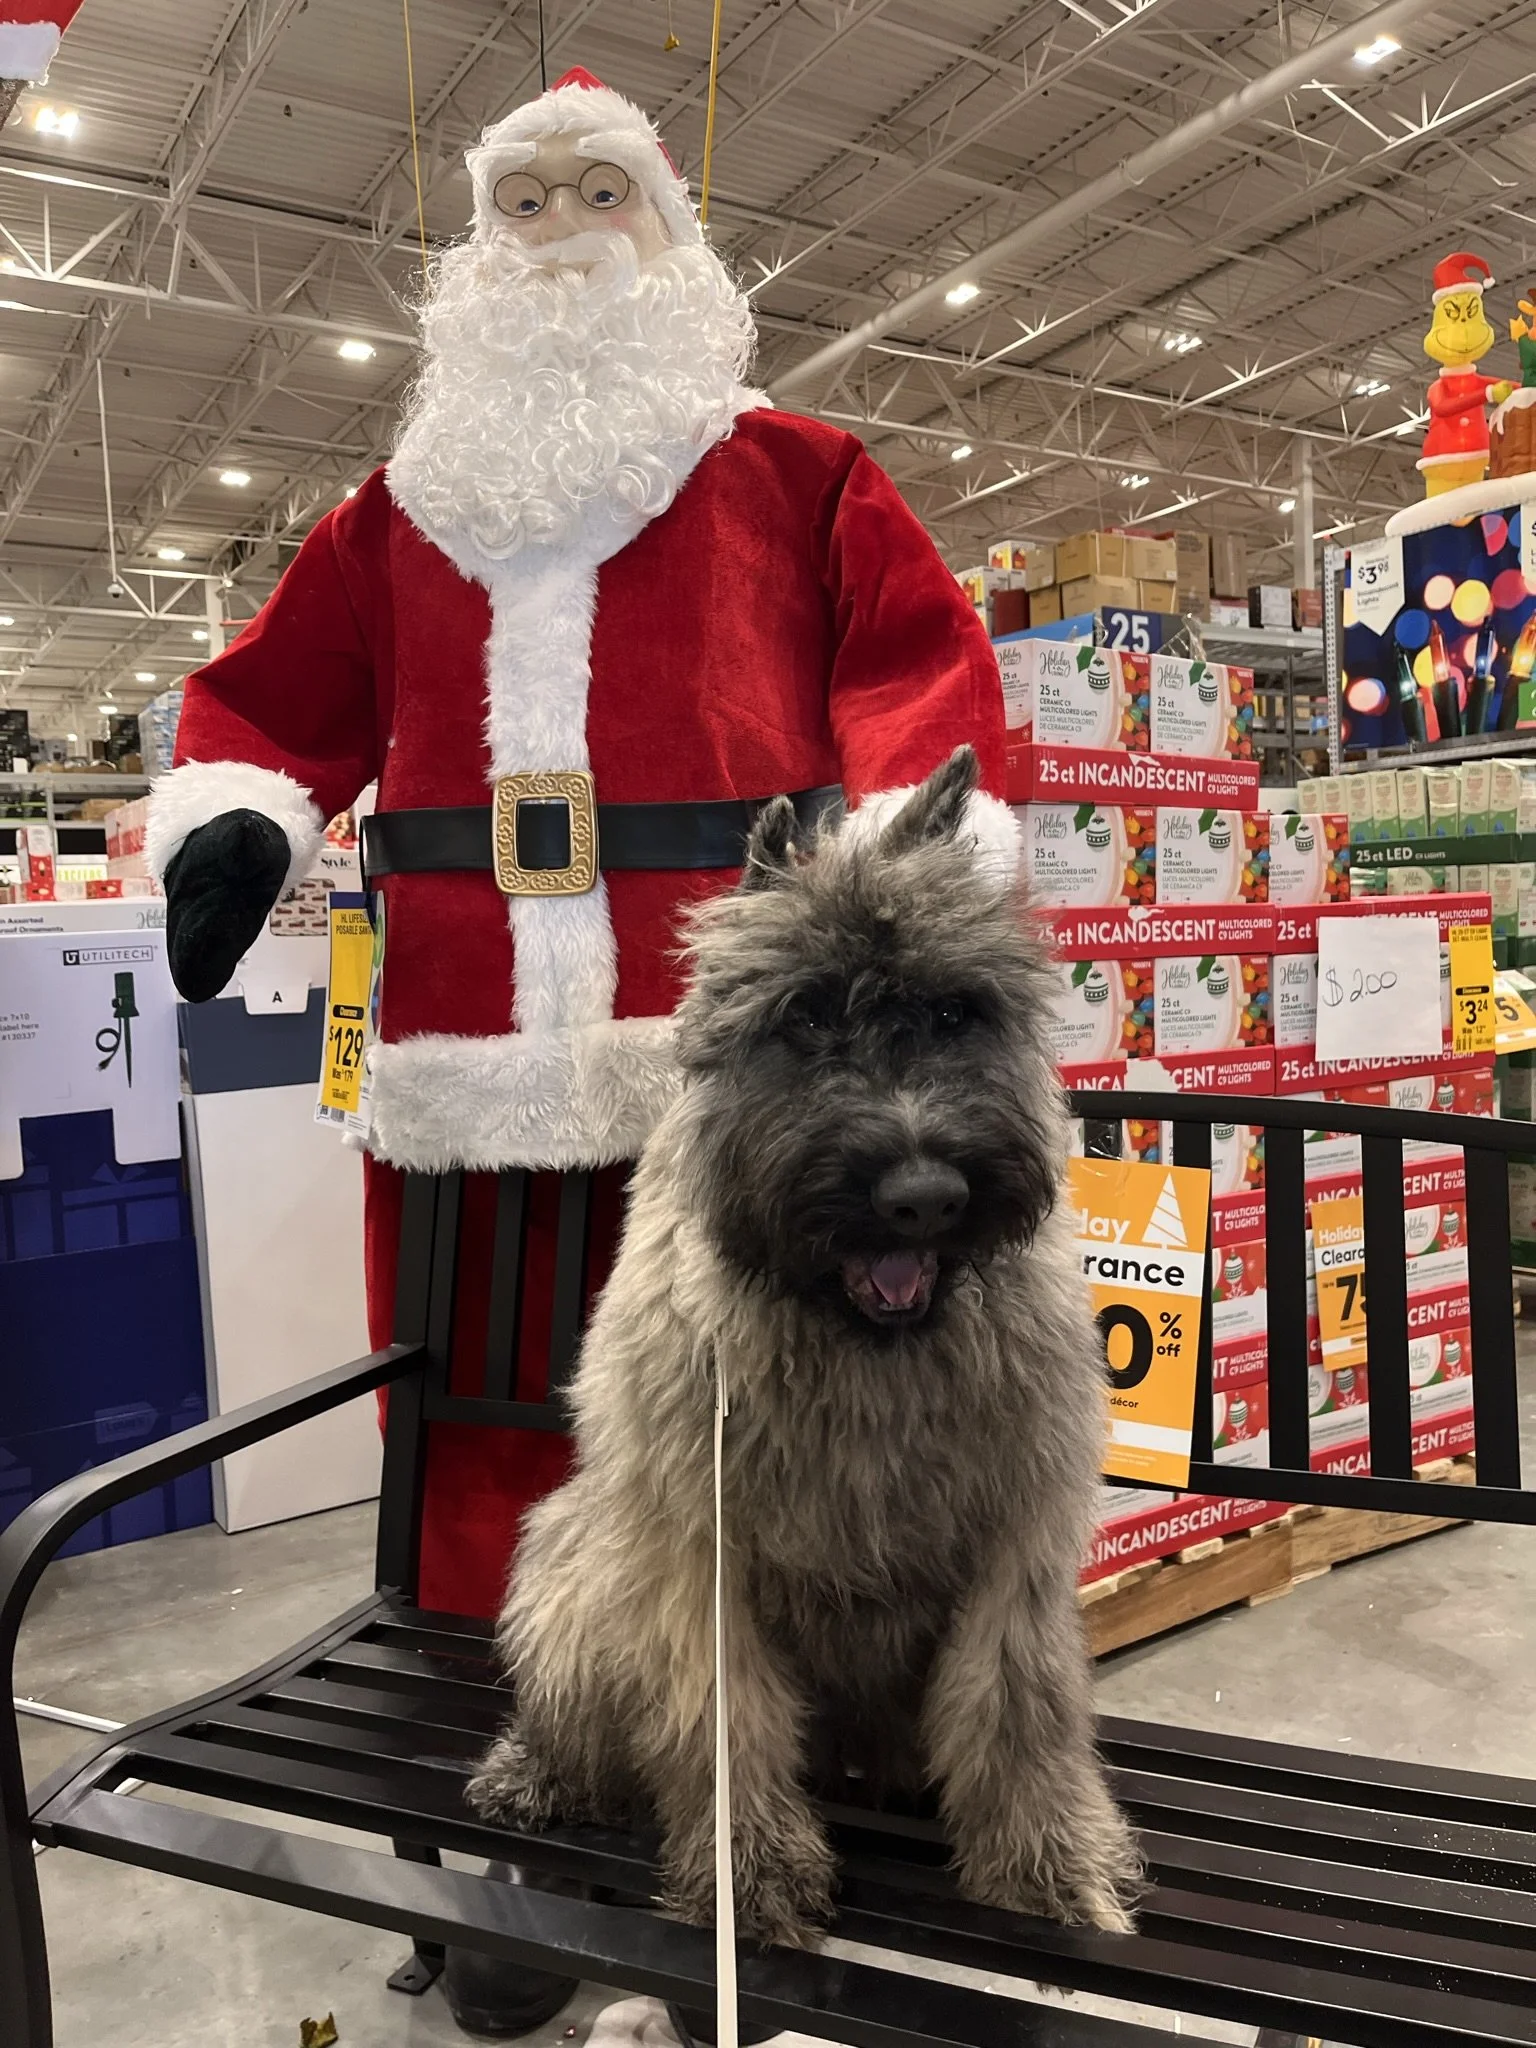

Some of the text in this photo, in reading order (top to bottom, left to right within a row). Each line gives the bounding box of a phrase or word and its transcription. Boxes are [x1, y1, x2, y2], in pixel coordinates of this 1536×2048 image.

[1111, 612, 1150, 652] 25
[1040, 650, 1071, 678] Holiday
[1040, 684, 1050, 696] 25
[1052, 688, 1060, 697] ct
[1040, 698, 1064, 707] CERAMIC
[1157, 696, 1167, 707] 25
[1040, 706, 1080, 716] MULTICOLORED
[1040, 759, 1206, 793] 25 ct INCANDESCENT
[1208, 773, 1256, 786] MULTICOLORED
[1208, 784, 1239, 796] C9 LIGHTS
[1034, 813, 1068, 840] Holiday
[1163, 816, 1192, 840] Holiday
[1034, 848, 1056, 859] 25 ct
[1163, 848, 1182, 859] 25 ct
[1356, 846, 1446, 862] 25 ct LED LIGHTS
[1034, 860, 1060, 868] CERAMIC
[1034, 868, 1078, 876] MULTICOLORED
[8, 916, 44, 924] Assorted
[1440, 908, 1488, 920] MULTICOLORED
[18, 925, 64, 934] Ornaments
[336, 924, 358, 935] POSABLE
[1218, 918, 1272, 930] MULTICOLORED
[1278, 920, 1296, 940] 25
[1298, 922, 1312, 940] ct
[1058, 928, 1072, 946] ct
[1078, 918, 1216, 945] INCANDESCENT
[1218, 930, 1253, 940] C9 LIGHTS
[82, 950, 150, 962] UTILITECH
[1161, 964, 1191, 990] Holiday
[1280, 962, 1309, 986] Holiday
[272, 991, 283, 1003] A
[1161, 998, 1180, 1008] 25 ct
[1280, 994, 1299, 1003] 25 ct
[1494, 996, 1519, 1022] 5
[1161, 1016, 1199, 1024] MULTICOLORED
[1218, 1060, 1271, 1075] MULTICOLORED
[1282, 1060, 1300, 1081] 25
[1302, 1062, 1315, 1078] ct
[332, 1068, 342, 1080] Was
[1218, 1073, 1252, 1086] C9 LIGHTS
[1225, 1220, 1234, 1231] C9
[1234, 1216, 1259, 1229] LIGHTS
[1159, 1312, 1182, 1340] %
[1156, 1343, 1181, 1358] off
[1229, 1366, 1239, 1376] C9
[1239, 1362, 1264, 1374] LIGHTS
[1110, 1397, 1138, 1409] décor
[1097, 1499, 1233, 1562] INCANDESCENT
